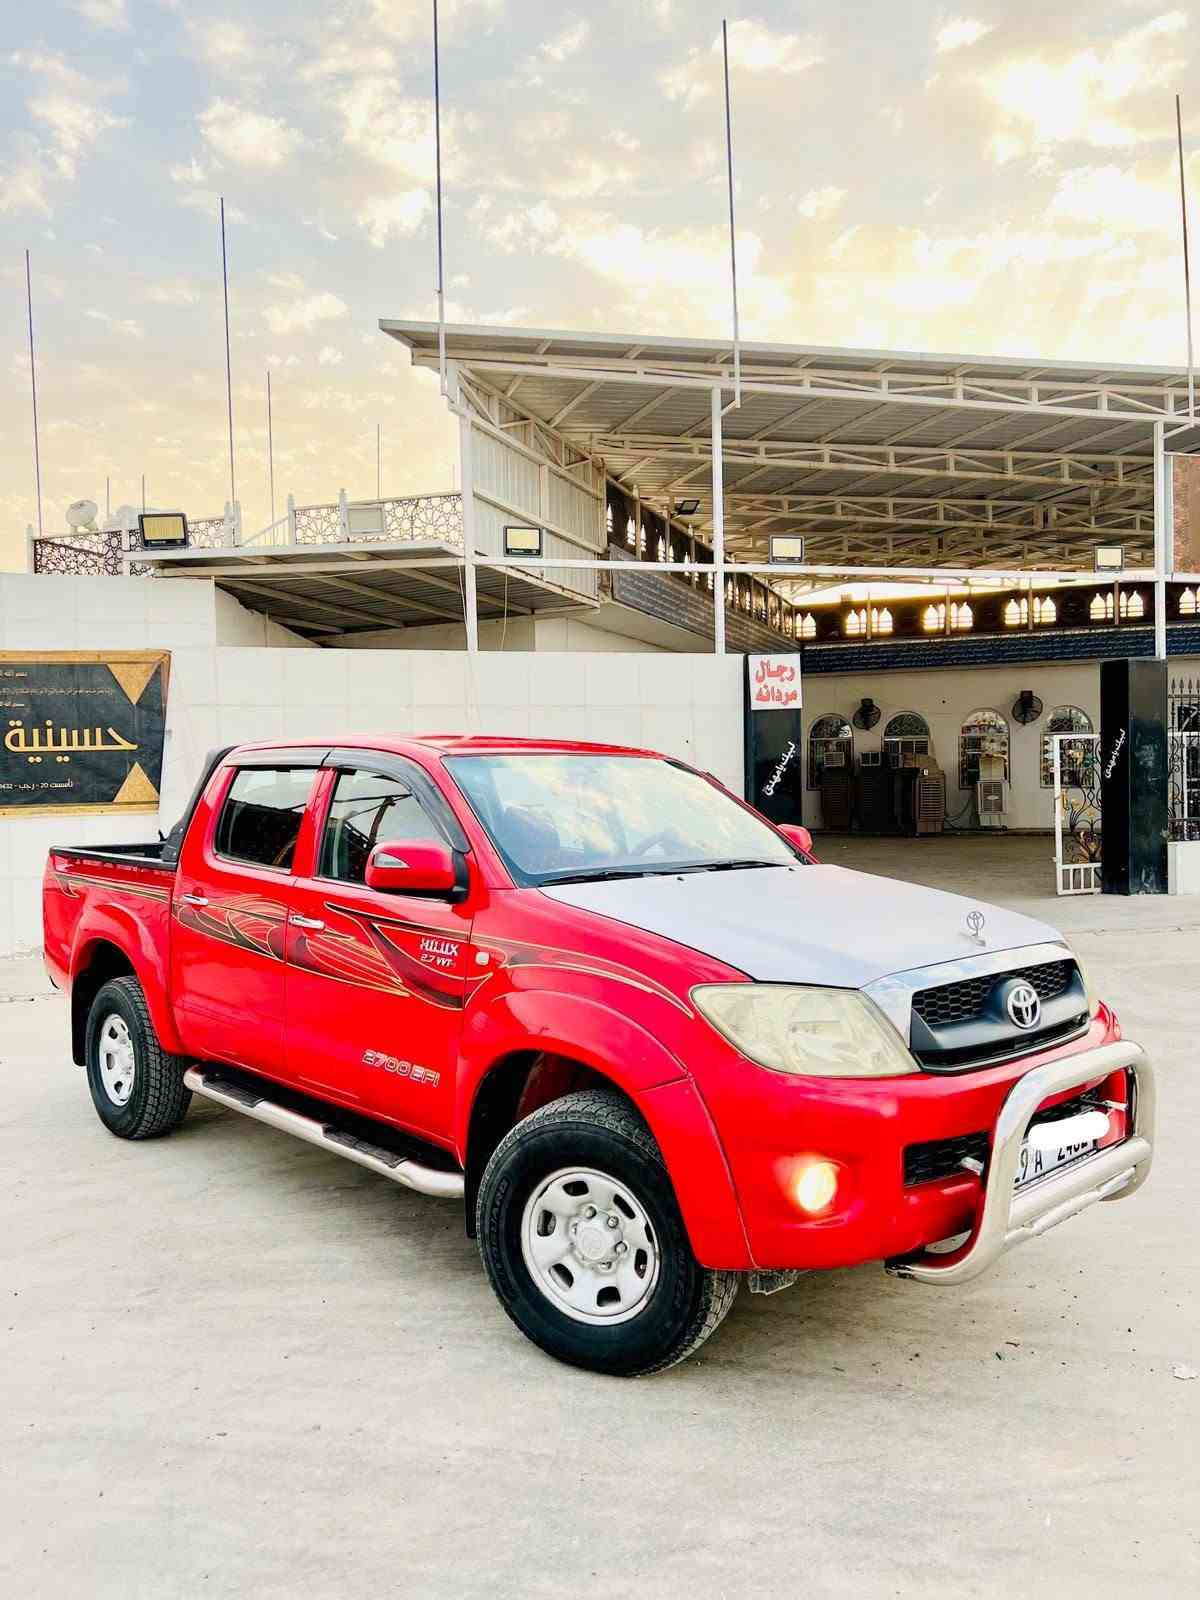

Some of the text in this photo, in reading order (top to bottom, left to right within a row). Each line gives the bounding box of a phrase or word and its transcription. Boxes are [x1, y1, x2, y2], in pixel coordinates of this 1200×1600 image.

[755, 660, 796, 683] رجال
[4, 719, 139, 763] حسينية
[420, 938, 459, 957] HILUX
[362, 1049, 440, 1087] 2700 EFI
